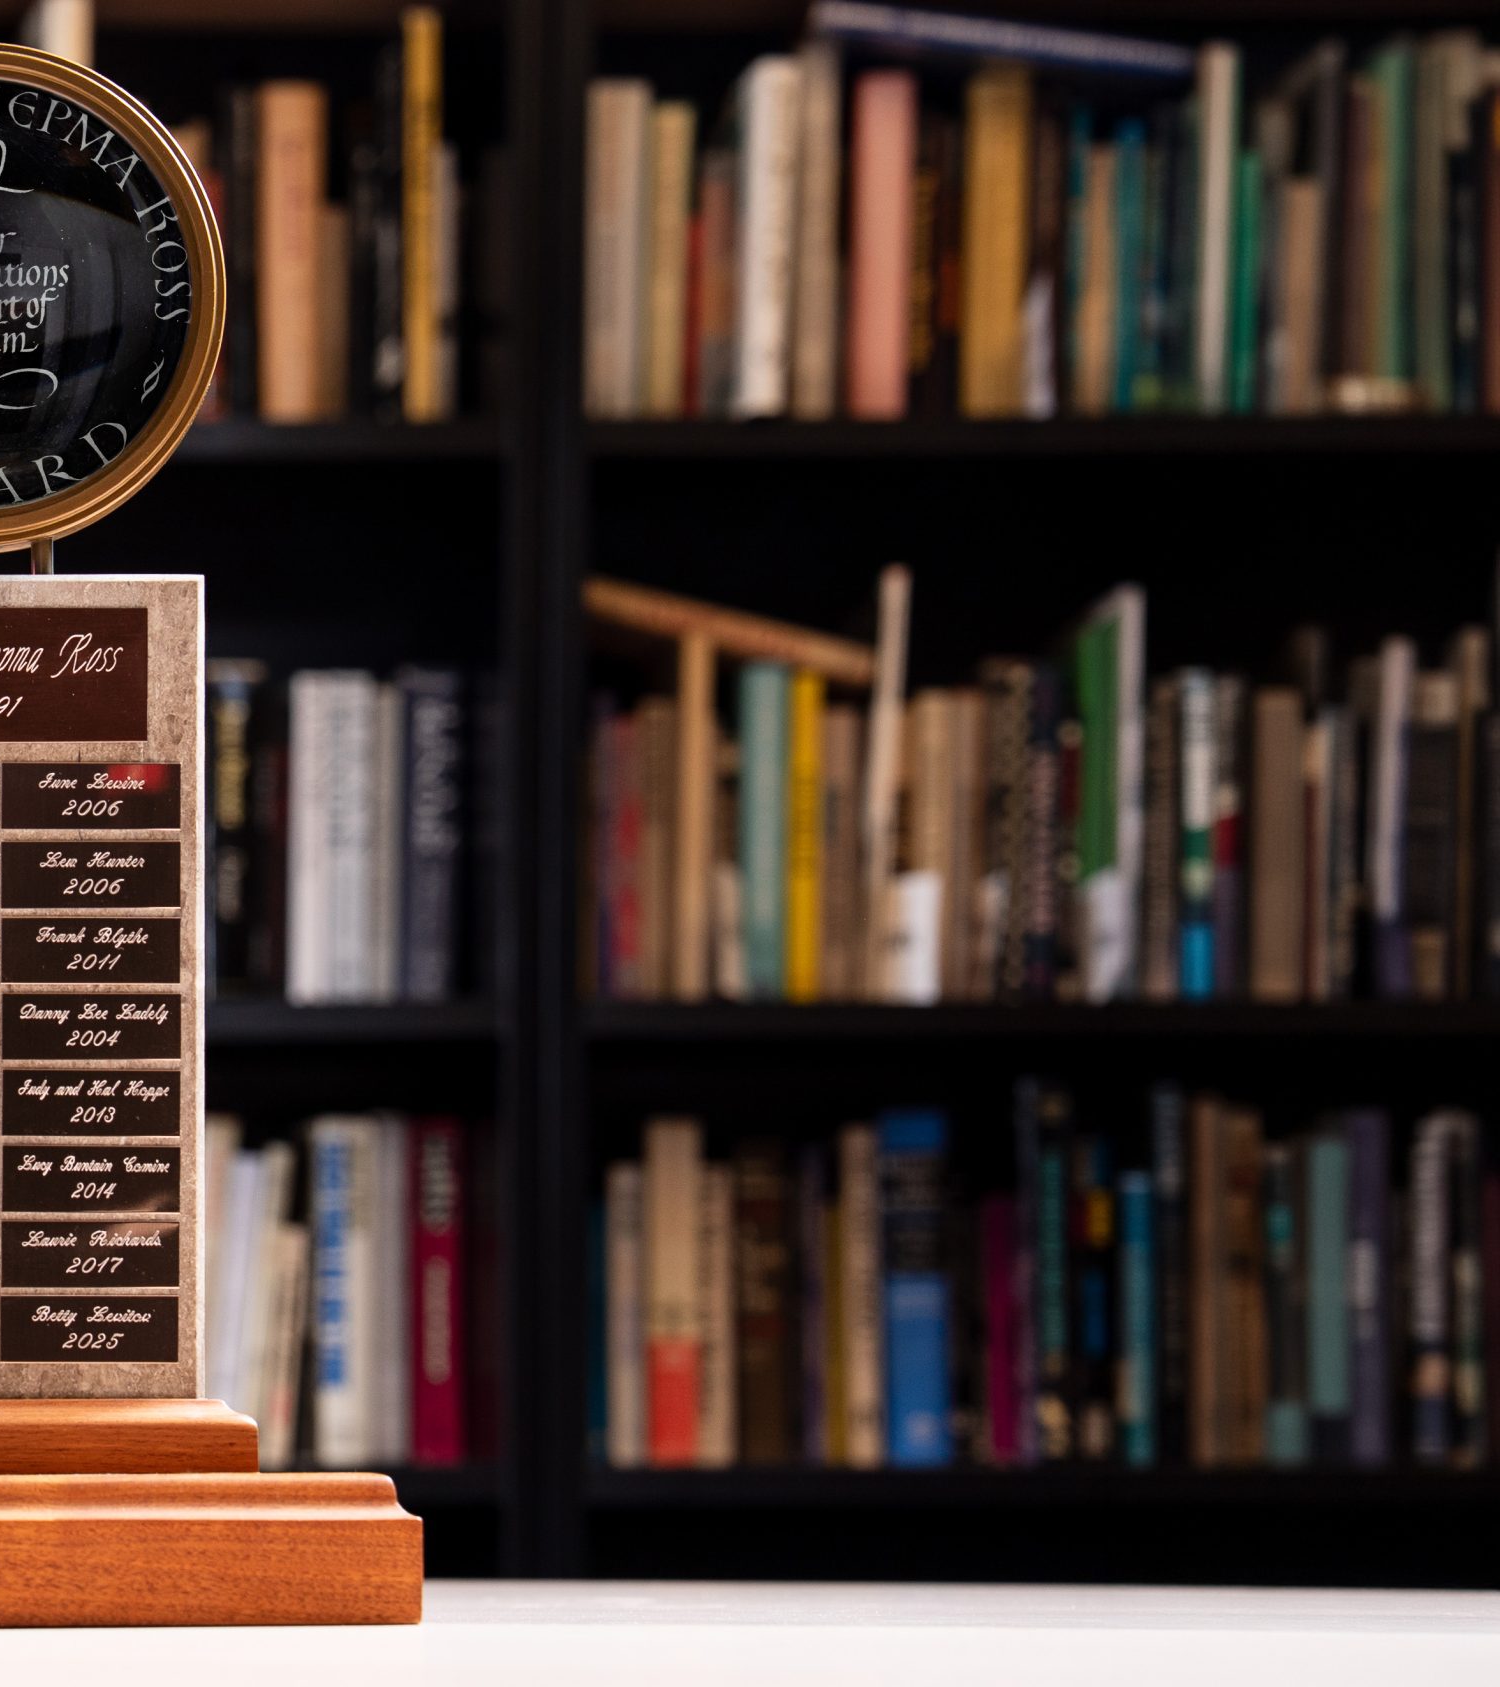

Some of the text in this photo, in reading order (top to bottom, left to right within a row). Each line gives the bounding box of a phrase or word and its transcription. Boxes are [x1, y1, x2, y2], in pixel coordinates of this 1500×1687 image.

[135, 196, 192, 323] ROSS
[26, 289, 60, 328] of
[51, 633, 123, 678] Ross
[39, 773, 145, 790] June Levine
[62, 800, 123, 816] 2006
[40, 852, 144, 867] Lew Hunter
[63, 879, 124, 894] 2006
[36, 927, 148, 948] Frank Blythe
[67, 954, 121, 970] 2011
[20, 1004, 168, 1024] Danny Lee Ladely
[66, 1031, 121, 1046] 2004
[18, 1079, 169, 1101] Judy and Hal Hoppe
[70, 1107, 115, 1122] 2013
[18, 1155, 169, 1176] Lucy Buntain Comine
[71, 1183, 116, 1198] 2014
[22, 1229, 162, 1247] Laurie Richards
[66, 1257, 123, 1273] 2017
[32, 1306, 151, 1327] Betty Levitov
[62, 1333, 124, 1349] 2025
